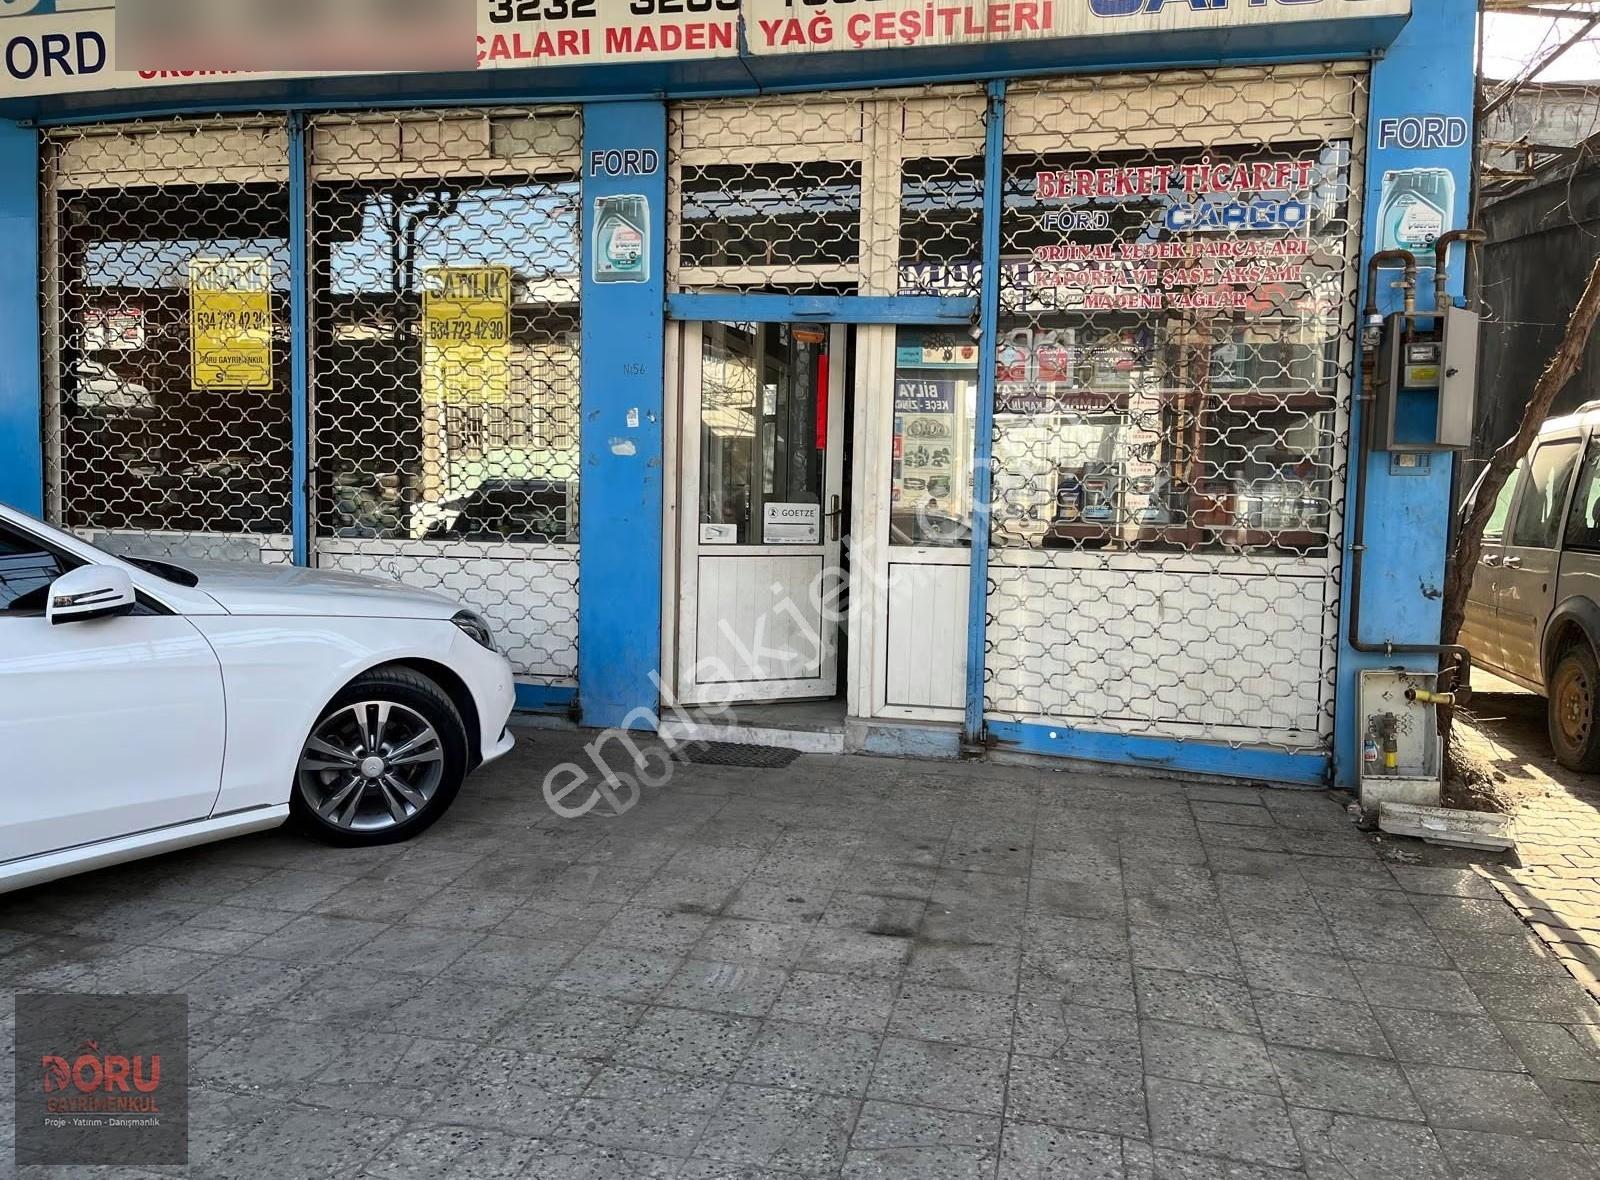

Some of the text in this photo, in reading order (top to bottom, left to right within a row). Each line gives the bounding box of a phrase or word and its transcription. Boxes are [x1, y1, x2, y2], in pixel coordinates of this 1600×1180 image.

[605, 22, 733, 54] MADEN
[758, 10, 834, 46] YAĞ
[1378, 116, 1468, 149] FORD
[590, 148, 659, 176] FORD
[1036, 155, 1315, 199] BEREKET TİCARET
[1043, 200, 1307, 232] FORD CARGO
[1119, 242, 1186, 260] YEDEK
[1033, 269, 1128, 287] KAPORTA
[1132, 268, 1158, 285] VE
[430, 320, 449, 340] 534
[452, 320, 471, 340] 723
[781, 508, 815, 518] GOETZE
